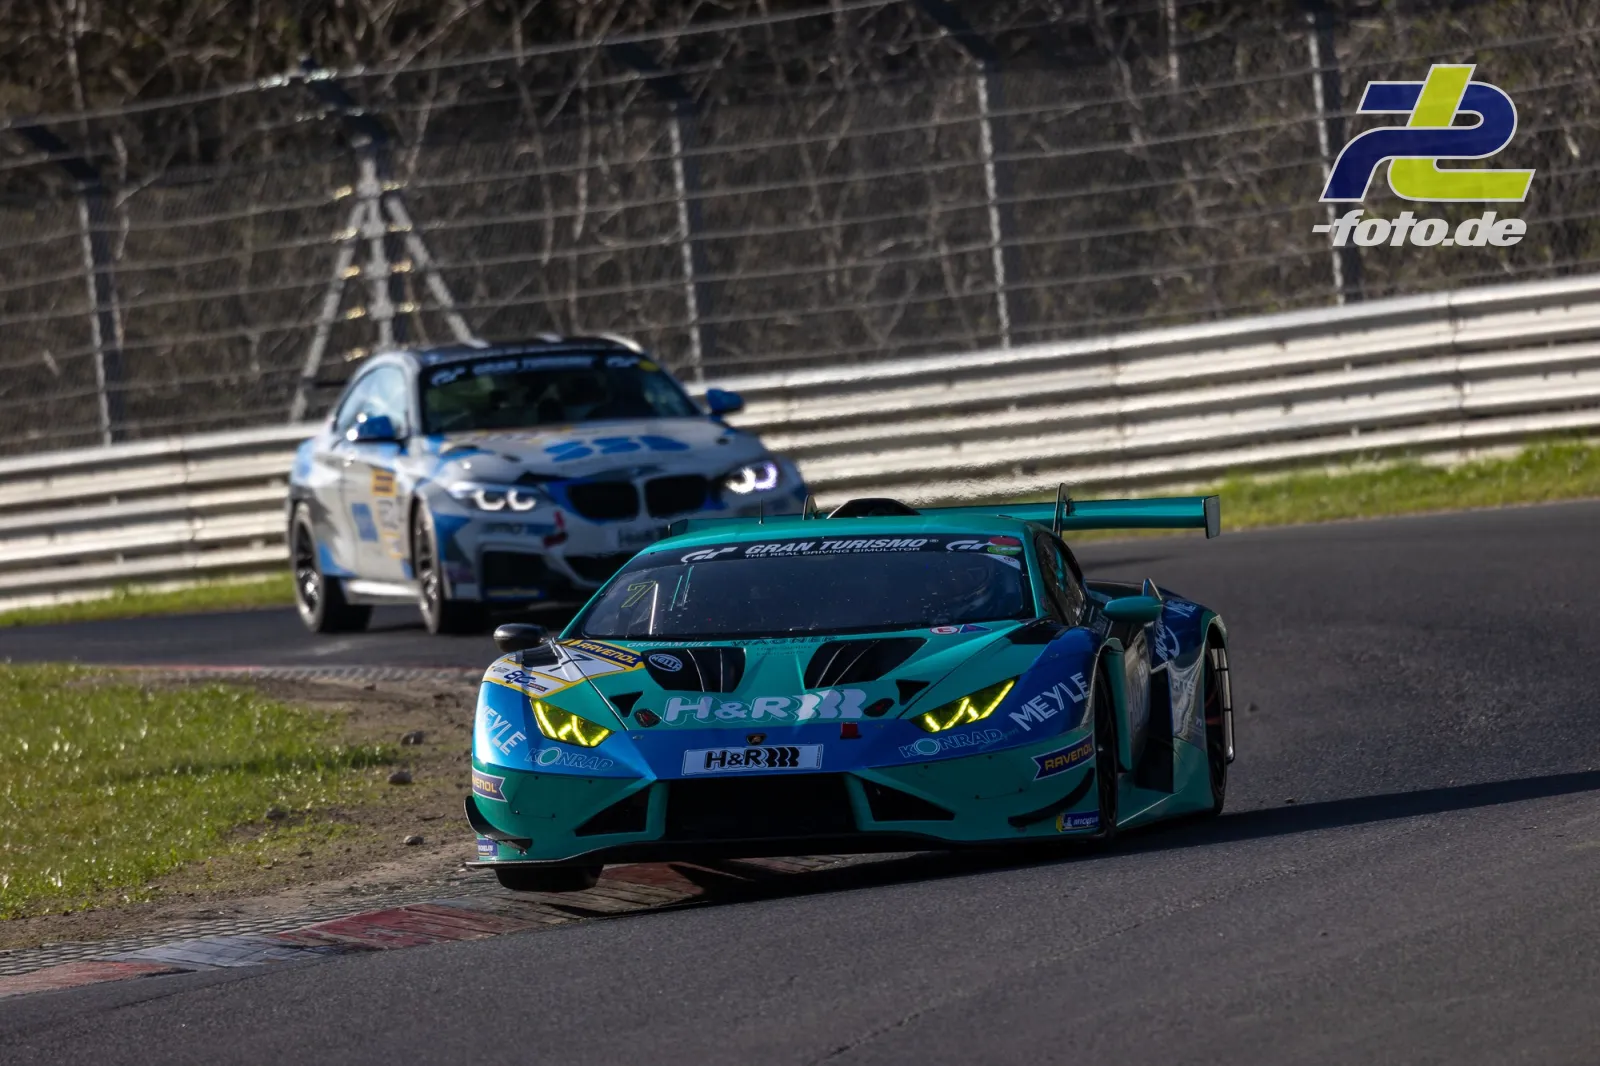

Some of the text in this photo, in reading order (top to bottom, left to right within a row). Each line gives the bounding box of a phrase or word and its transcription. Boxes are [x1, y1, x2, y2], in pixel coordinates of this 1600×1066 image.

[745, 538, 928, 554] GRAN TURISMO
[577, 642, 636, 665] RAVENOL
[1008, 671, 1090, 732] MEYLE
[899, 728, 1003, 758] KONRAD
[524, 747, 614, 771] KONRAD
[705, 748, 764, 769] H&R
[1045, 743, 1093, 772] RAVENOL
